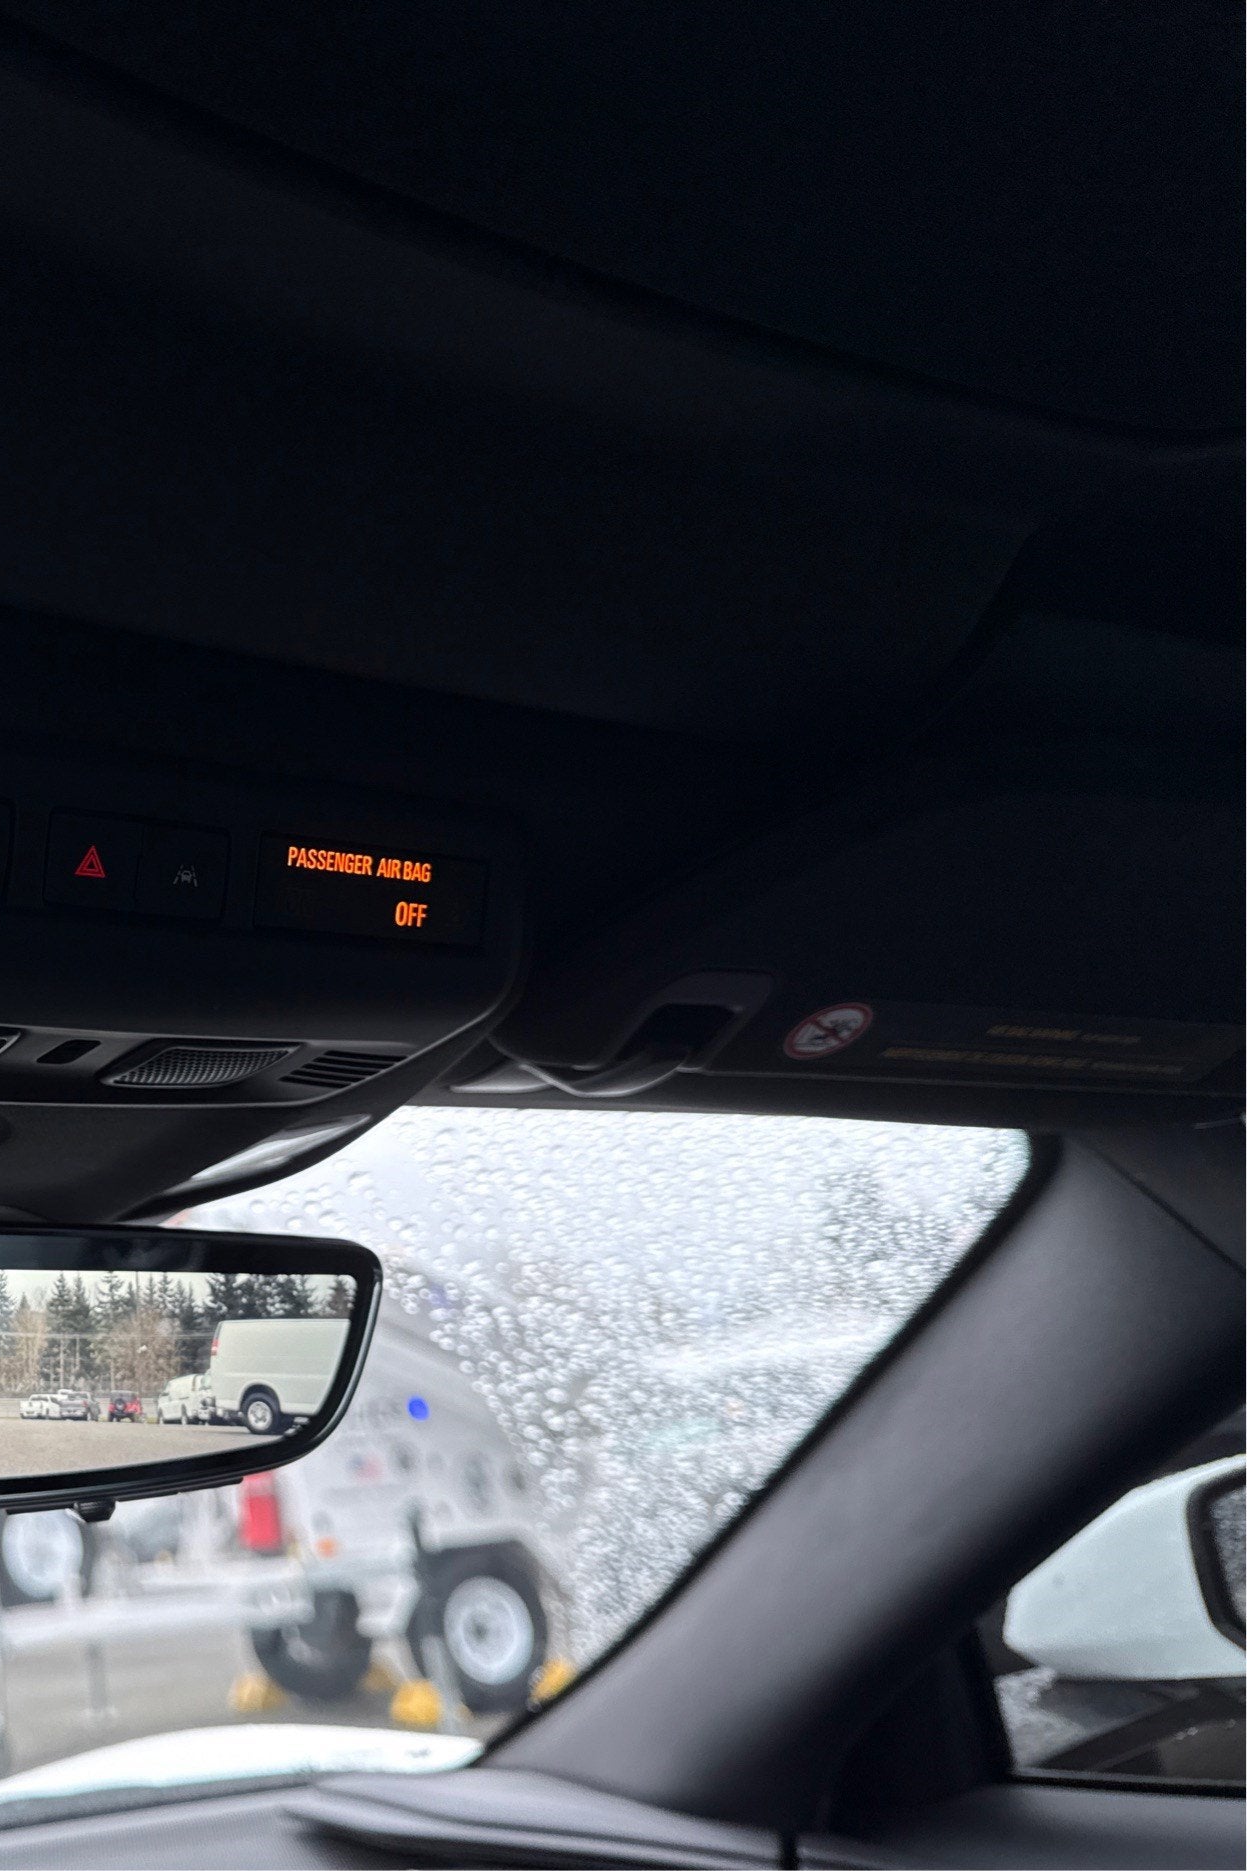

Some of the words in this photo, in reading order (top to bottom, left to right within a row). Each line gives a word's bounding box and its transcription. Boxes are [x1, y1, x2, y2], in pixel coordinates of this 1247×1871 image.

[287, 846, 372, 875] PASSENGER
[376, 857, 402, 880] AIR
[403, 861, 431, 883] BAG
[395, 901, 427, 927] OFF
